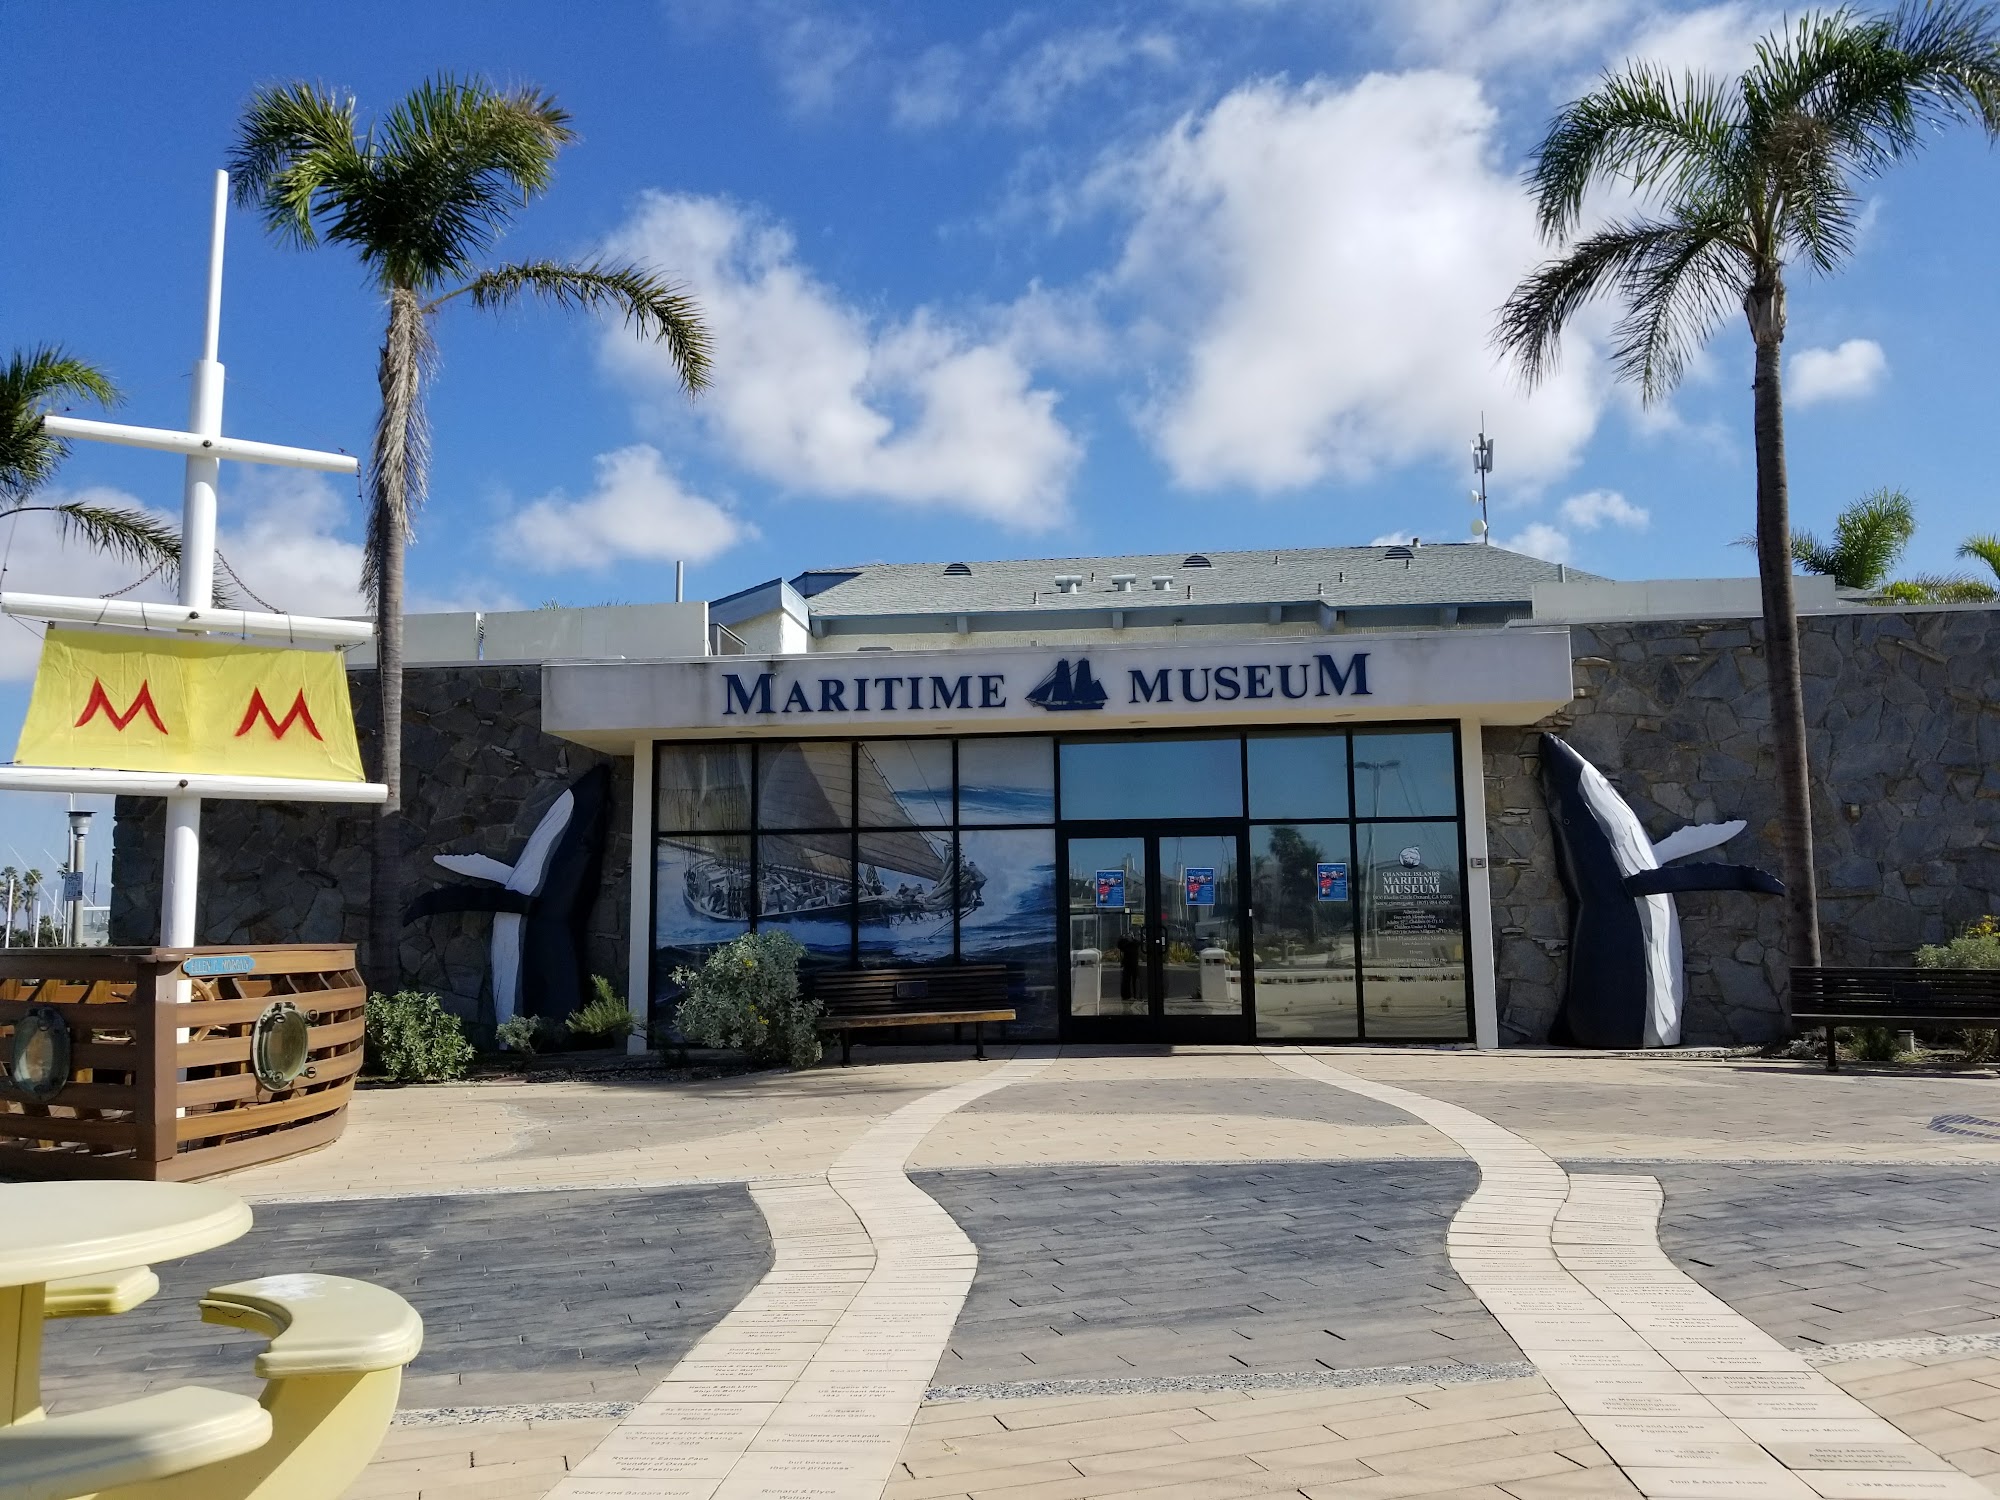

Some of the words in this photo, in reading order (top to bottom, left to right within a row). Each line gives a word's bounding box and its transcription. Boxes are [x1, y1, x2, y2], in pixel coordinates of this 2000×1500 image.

[722, 673, 1006, 715] MARITIME
[1128, 653, 1372, 704] MUSEUM
[1384, 885, 1440, 894] MUSEUM
